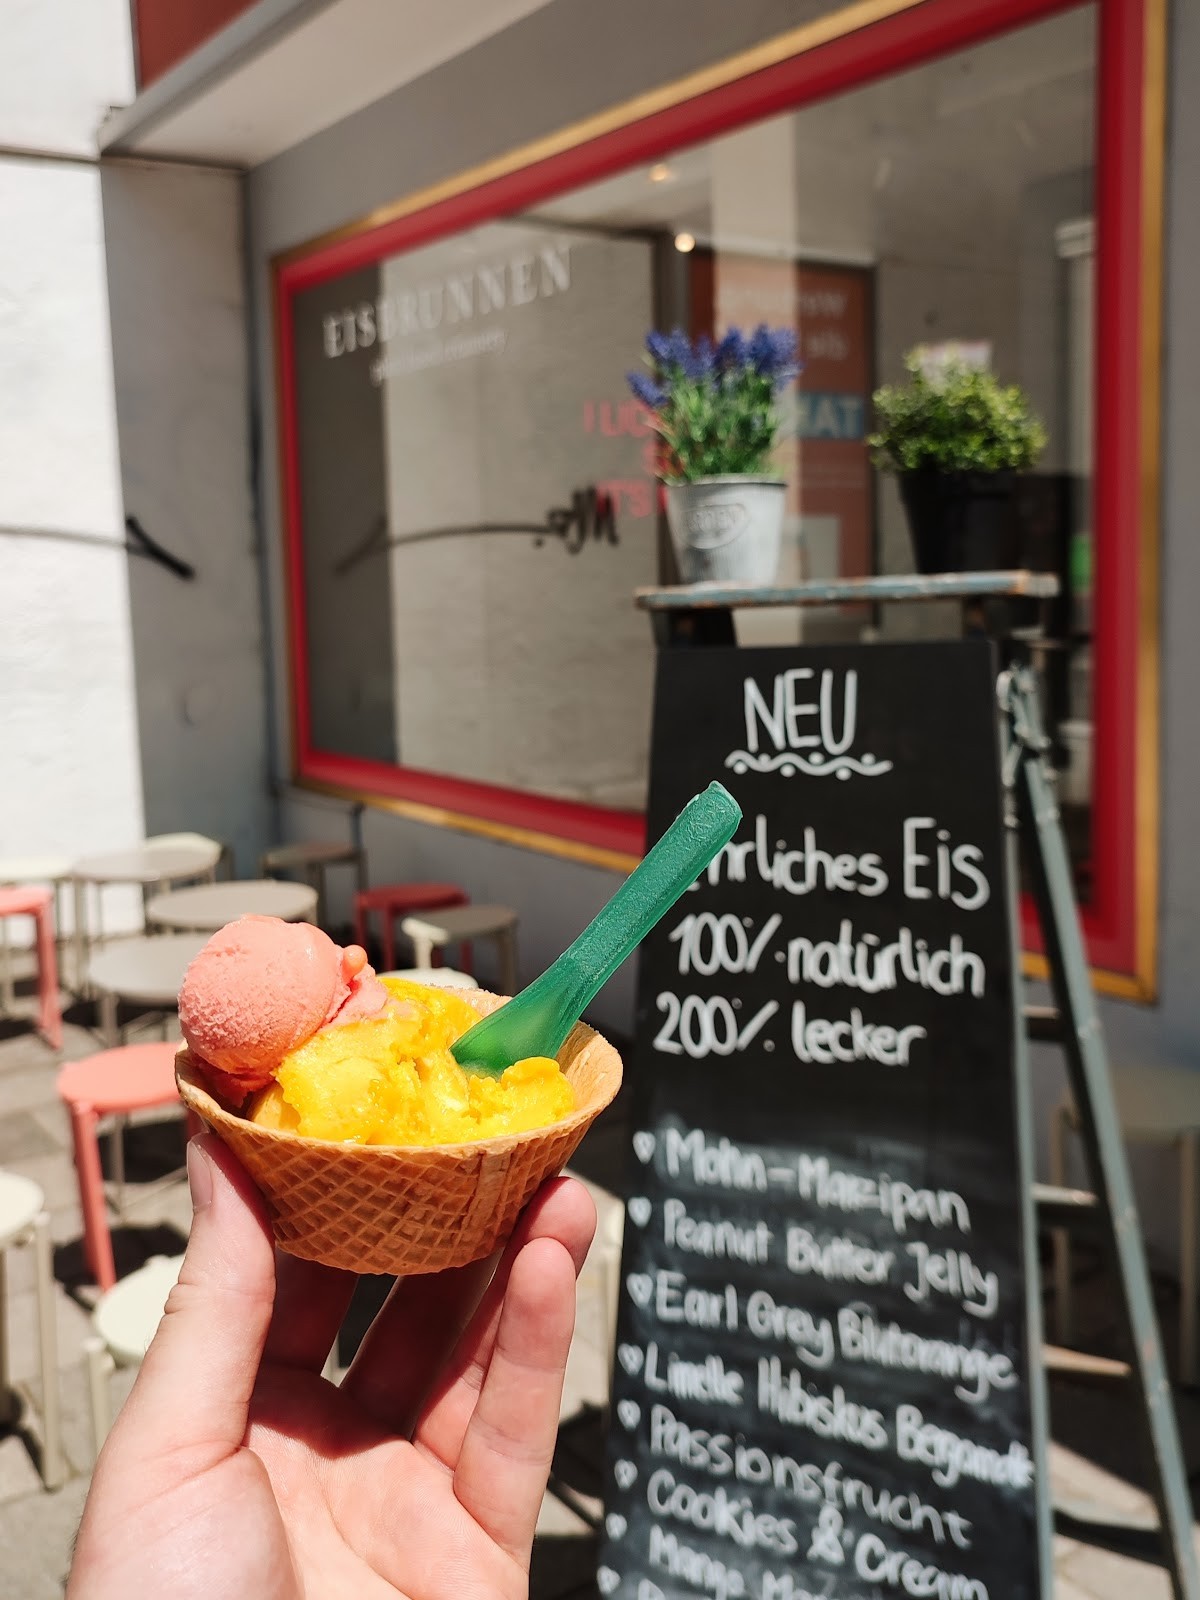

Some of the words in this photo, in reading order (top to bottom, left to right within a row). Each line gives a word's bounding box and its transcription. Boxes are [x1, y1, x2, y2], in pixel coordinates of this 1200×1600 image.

[322, 244, 572, 358] EISBRUNNEN
[744, 668, 858, 756] NEU
[687, 813, 889, 897] hrliches
[903, 816, 991, 911] Eis
[669, 911, 786, 977] 100%
[788, 919, 986, 998] natürlich
[653, 991, 780, 1059] 200%
[791, 1001, 928, 1066] lecker
[663, 1198, 775, 1265] Peanut
[786, 1225, 897, 1286] Butter
[903, 1241, 999, 1320] Jelly
[656, 1269, 738, 1332] Earl
[746, 1289, 835, 1371] Grey
[757, 1355, 889, 1450] Hibiskus
[646, 1467, 800, 1556] Cookies
[806, 1503, 852, 1566] &
[854, 1532, 990, 1600] Cream
